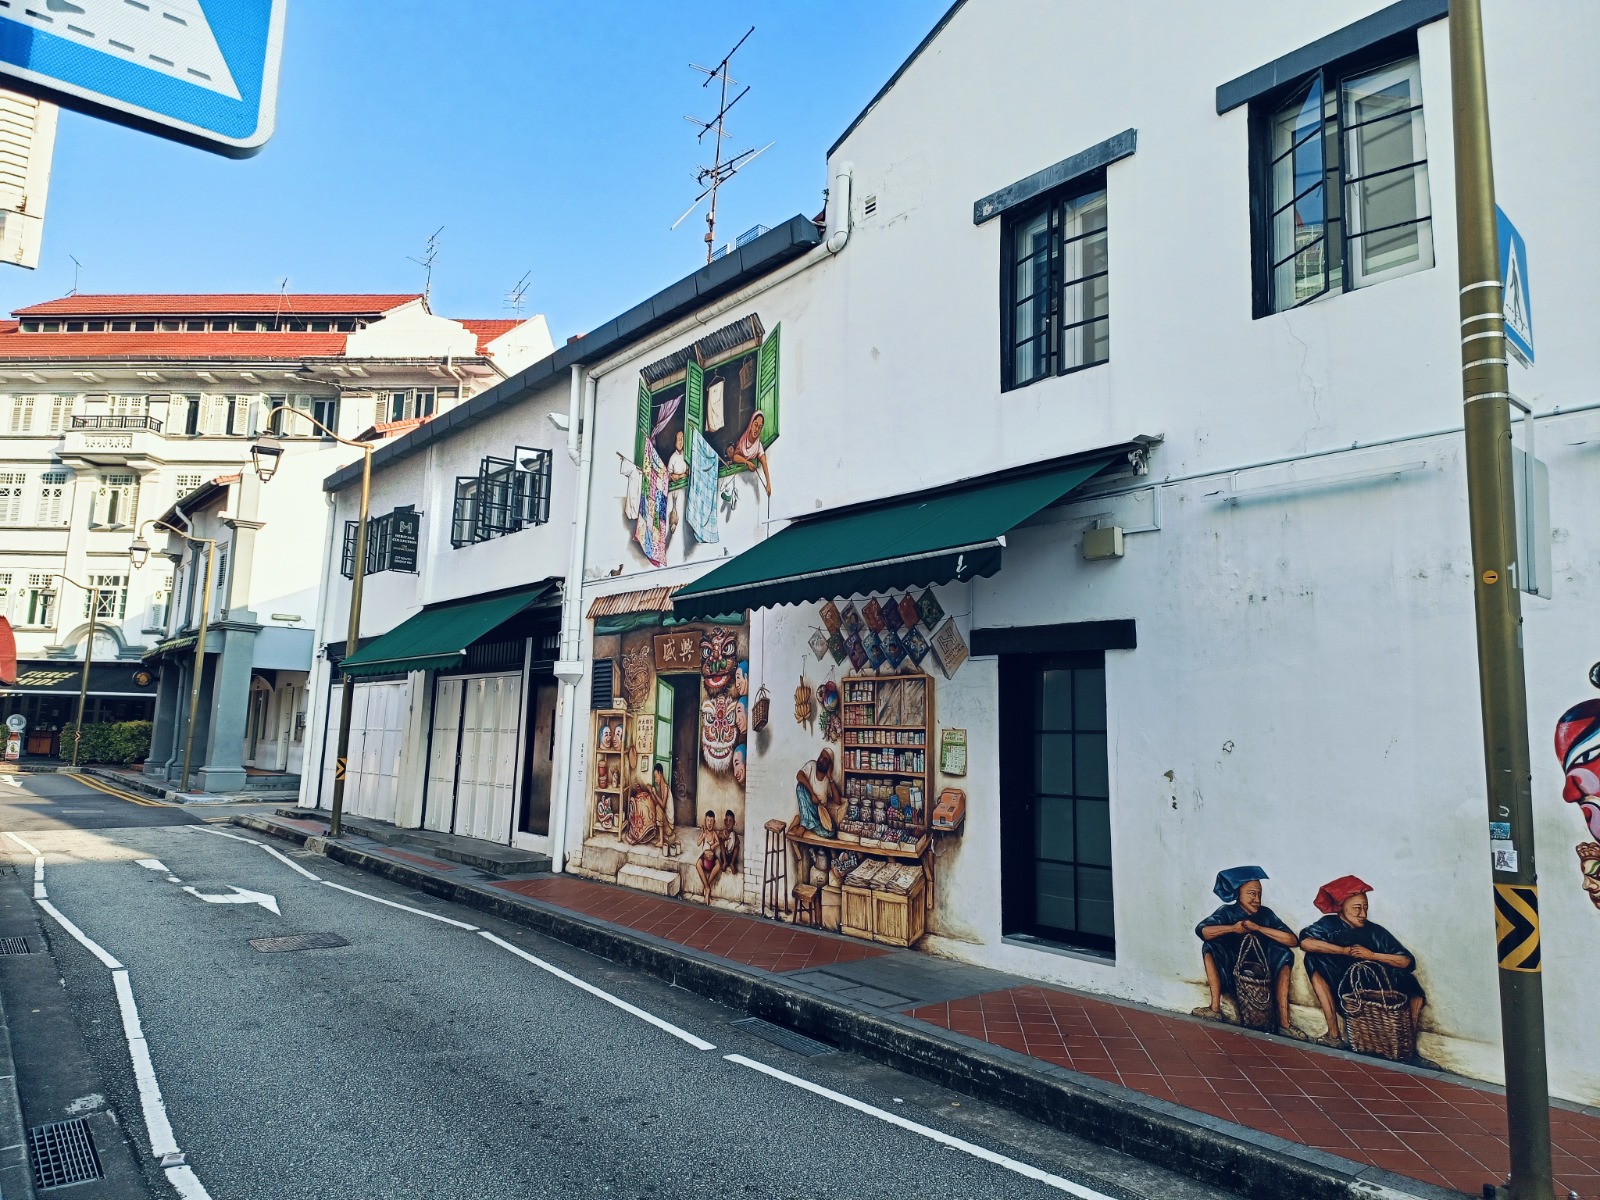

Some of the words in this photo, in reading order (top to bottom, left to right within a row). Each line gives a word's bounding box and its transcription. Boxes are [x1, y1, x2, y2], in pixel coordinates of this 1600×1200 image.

[1507, 562, 1517, 589] 1
[20, 671, 79, 679] FIERCE
[347, 674, 352, 682] 2
